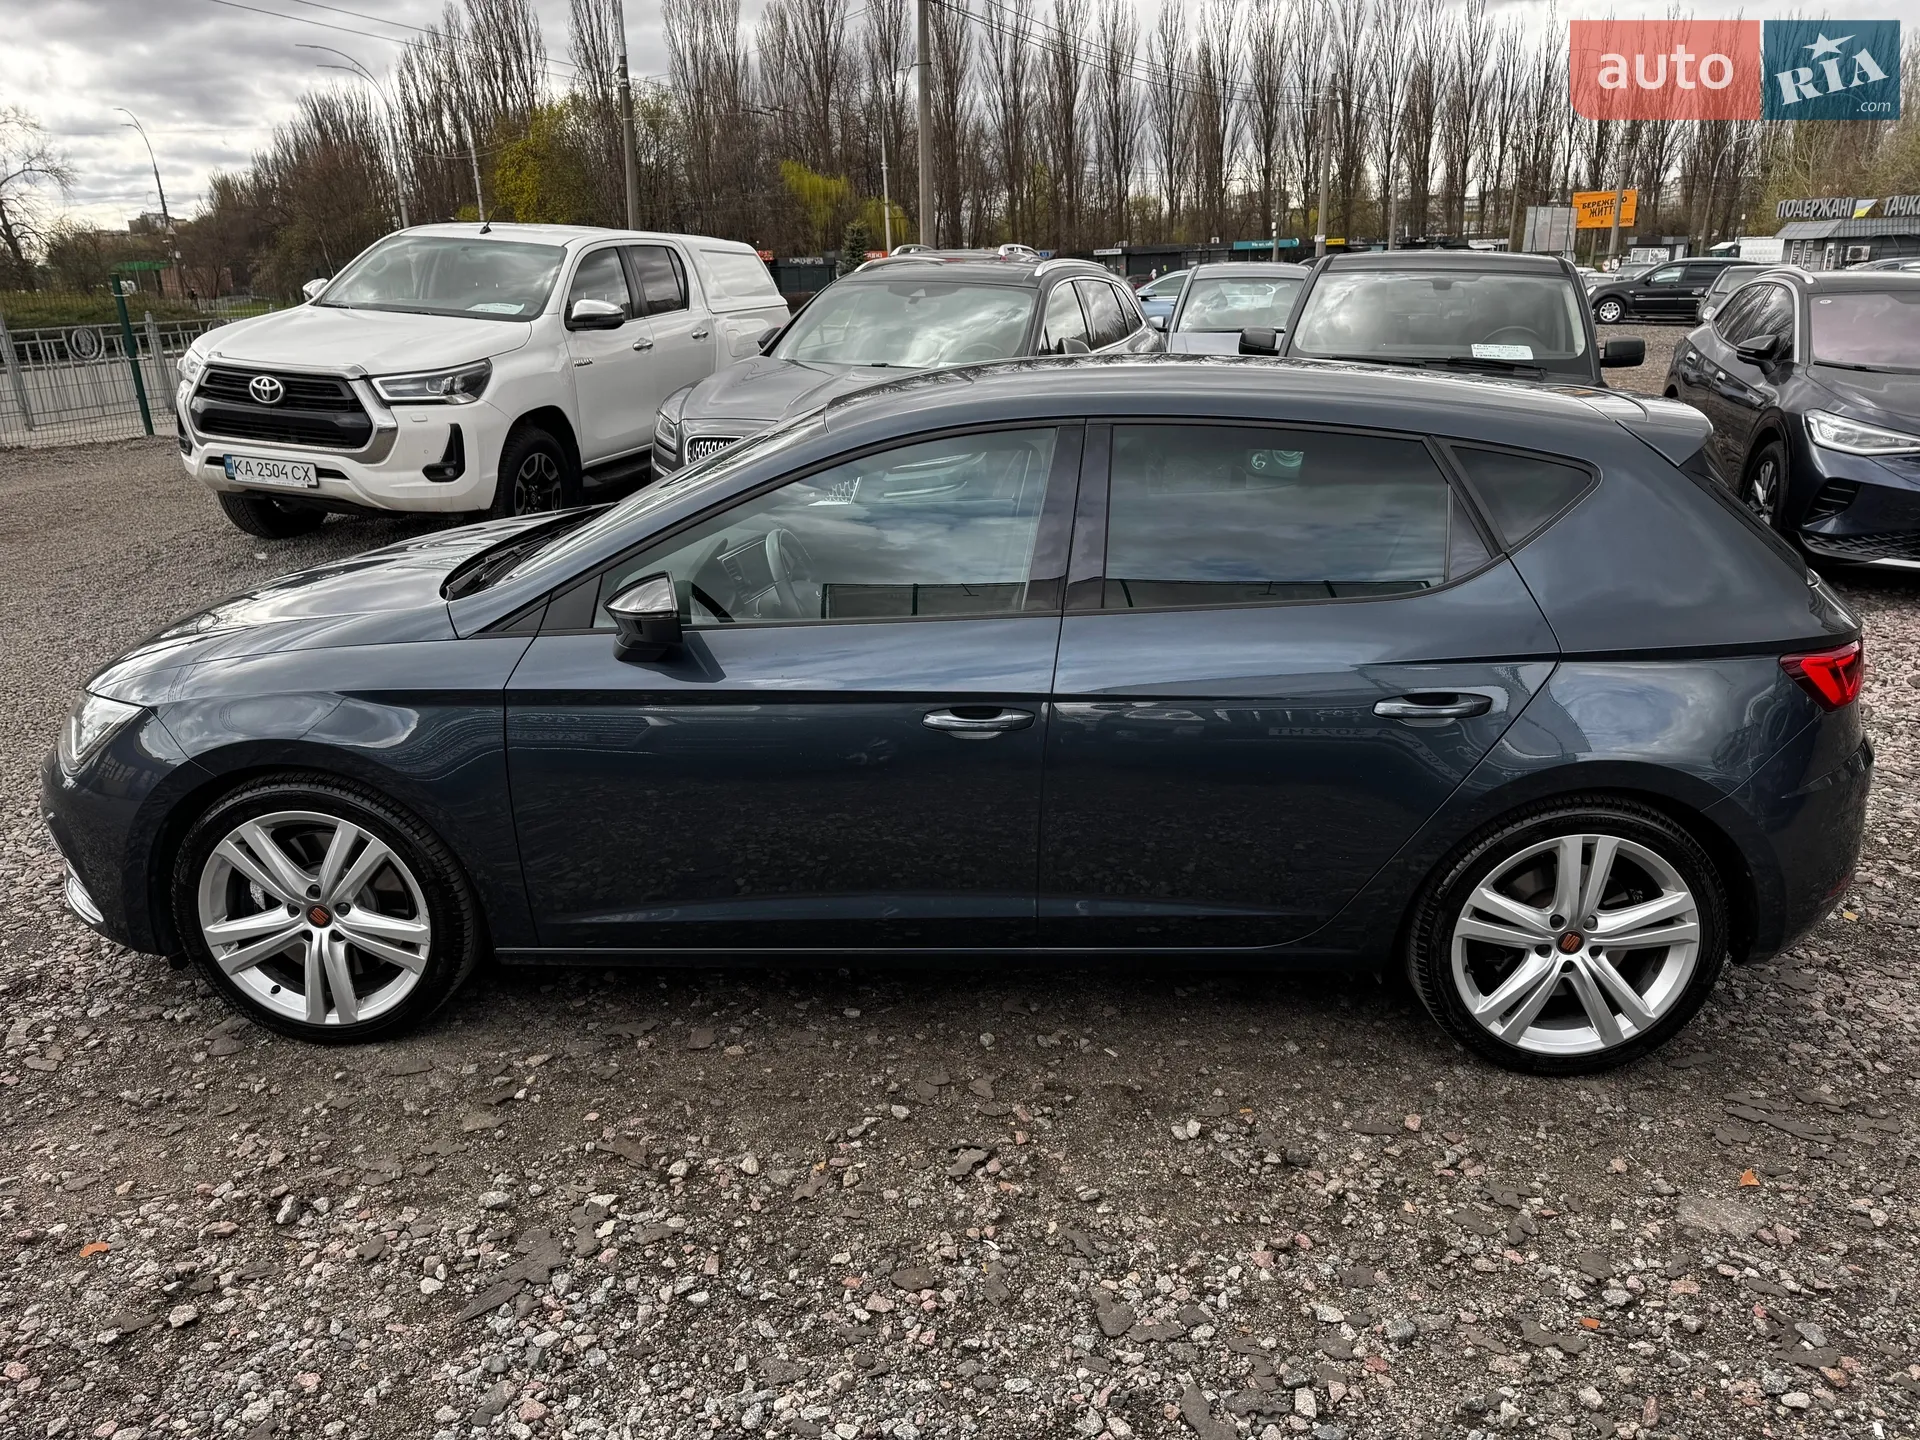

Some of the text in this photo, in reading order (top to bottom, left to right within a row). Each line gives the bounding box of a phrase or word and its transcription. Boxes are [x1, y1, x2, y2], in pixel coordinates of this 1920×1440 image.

[1582, 196, 1627, 209] БЕРЕЖЕО
[1776, 197, 1854, 218] ПОДЕРЖАНІ
[233, 459, 254, 476] KA
[256, 462, 288, 480] 2504
[291, 465, 312, 482] CX
